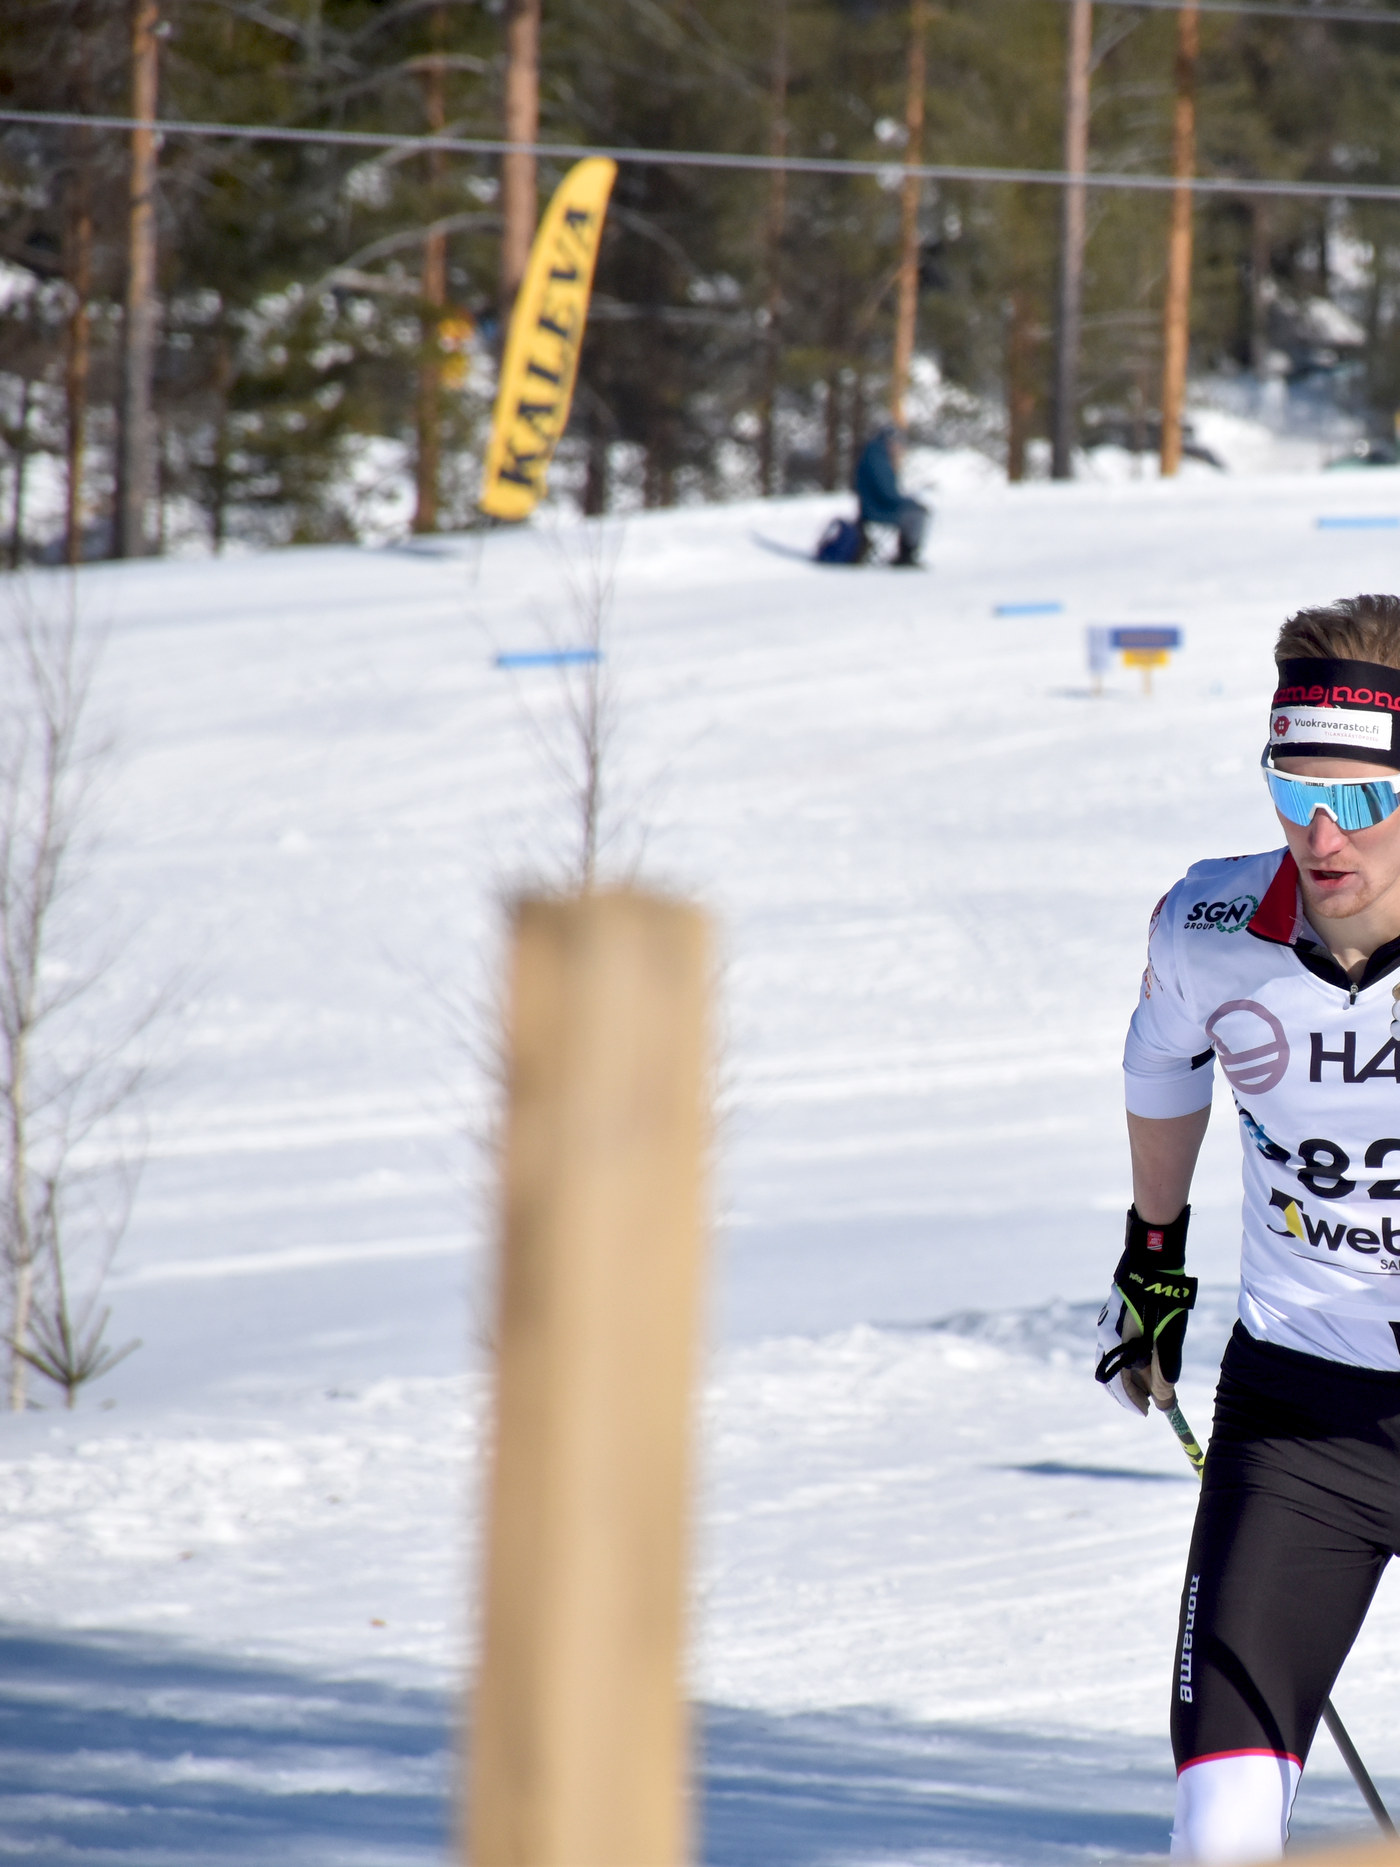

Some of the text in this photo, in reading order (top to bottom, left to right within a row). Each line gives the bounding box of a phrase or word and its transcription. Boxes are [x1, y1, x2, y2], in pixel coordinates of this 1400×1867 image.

[499, 207, 596, 488] KALEVA
[1294, 717, 1380, 736] Vuokravarastot.fi
[1186, 901, 1248, 924] SGN
[1183, 921, 1215, 931] GROUP
[1179, 1573, 1200, 1704] noname
